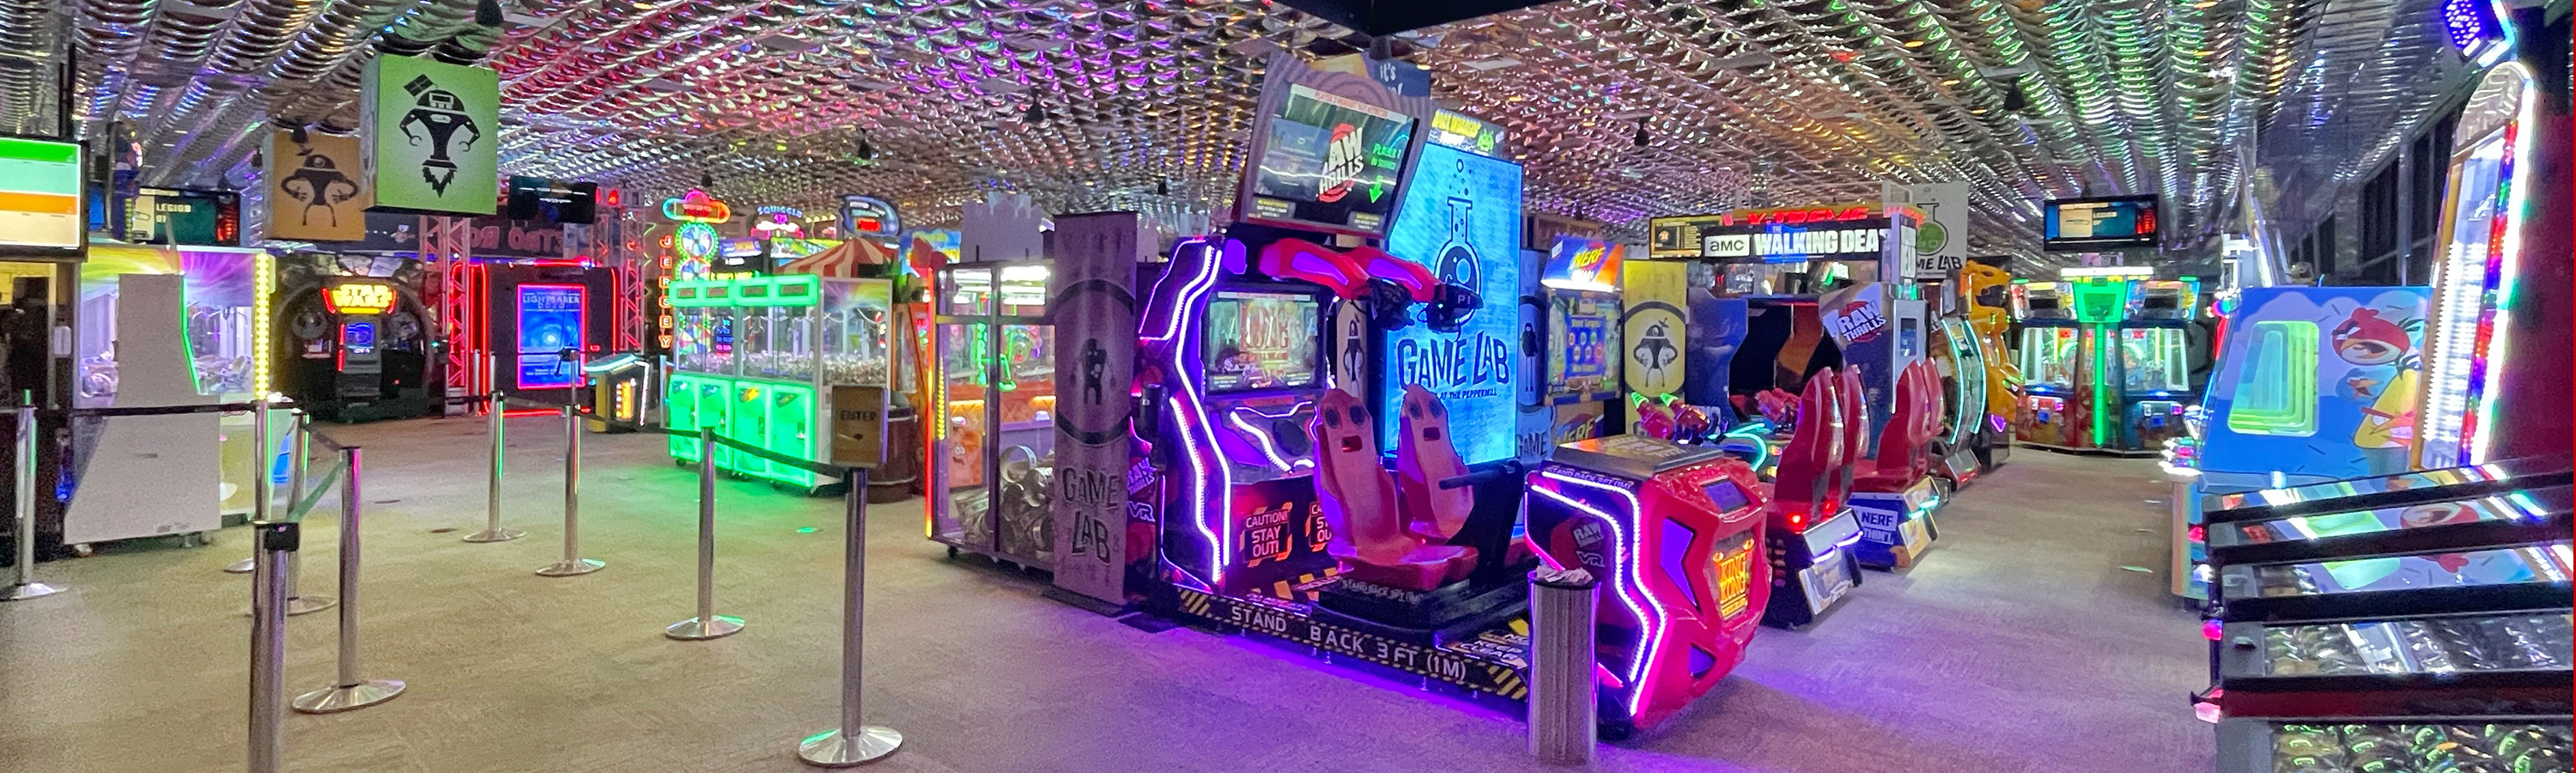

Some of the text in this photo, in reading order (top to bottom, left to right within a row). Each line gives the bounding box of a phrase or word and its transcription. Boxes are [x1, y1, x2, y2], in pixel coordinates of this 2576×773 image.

[1328, 127, 1363, 172] AW
[1753, 229, 1838, 256] WALKING
[1574, 247, 1607, 269] NERF
[1917, 255, 1963, 271] ME LAB
[331, 290, 393, 307] WARS
[340, 283, 390, 296] STAR
[1836, 301, 1880, 333] RAW
[1843, 314, 1887, 342] THRILLS
[1398, 330, 1510, 389] GAME LAB
[1449, 390, 1461, 399] THE
[1063, 466, 1121, 511] GAME
[1246, 511, 1288, 528] CAUTION!
[1862, 511, 1893, 526] NERF
[1072, 510, 1112, 564] LAB
[1252, 526, 1281, 544] STAY
[1252, 540, 1279, 557] OUT!
[1231, 606, 1287, 632] STAND
[1310, 625, 1364, 653] BACK
